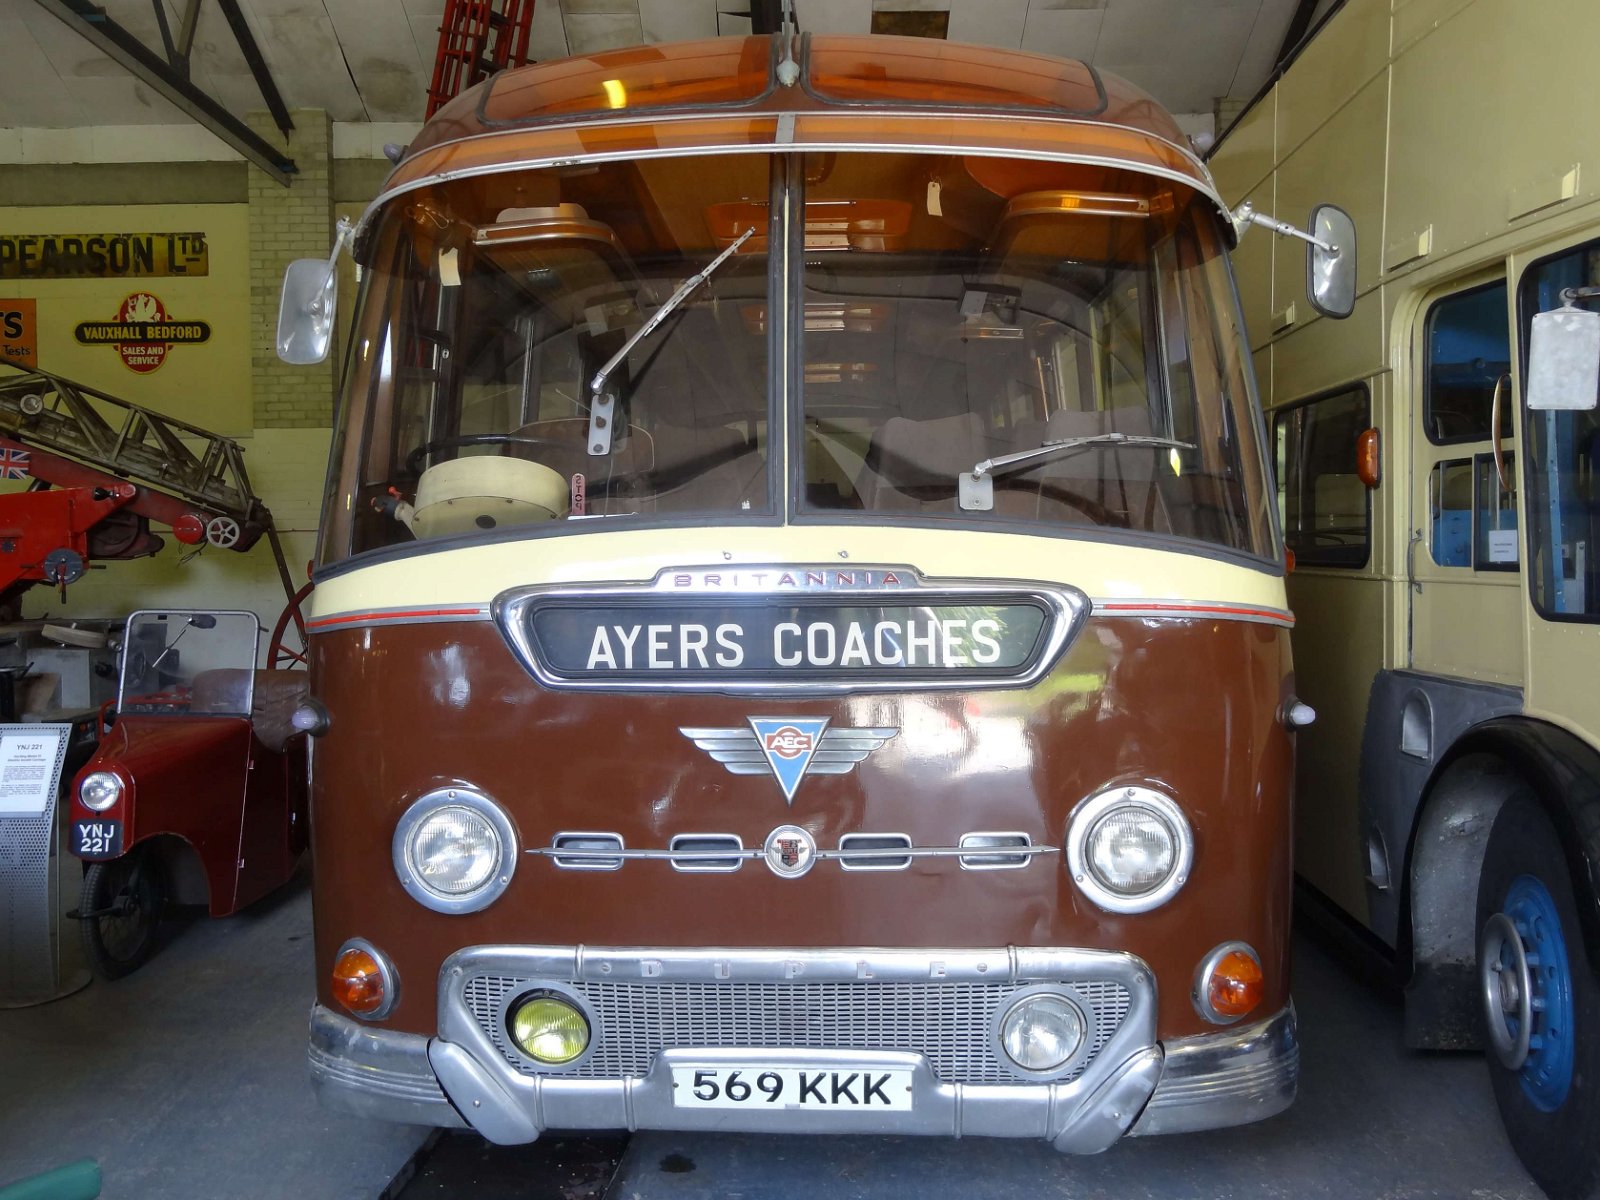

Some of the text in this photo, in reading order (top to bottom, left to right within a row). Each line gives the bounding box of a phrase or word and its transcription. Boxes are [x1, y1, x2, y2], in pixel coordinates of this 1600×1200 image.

[0, 237, 154, 275] PEARSON
[84, 325, 202, 340] VAUXHALL BEDFORD
[122, 346, 164, 356] SALES AND
[128, 356, 159, 365] SERVICE
[674, 571, 901, 587] BRITANNIA
[585, 619, 1002, 670] AYERS COACHES
[770, 735, 809, 749] AEC
[79, 823, 115, 838] YNJ
[80, 837, 110, 853] 221
[641, 960, 947, 980] DUPLE
[692, 1070, 892, 1105] 569 KKK
